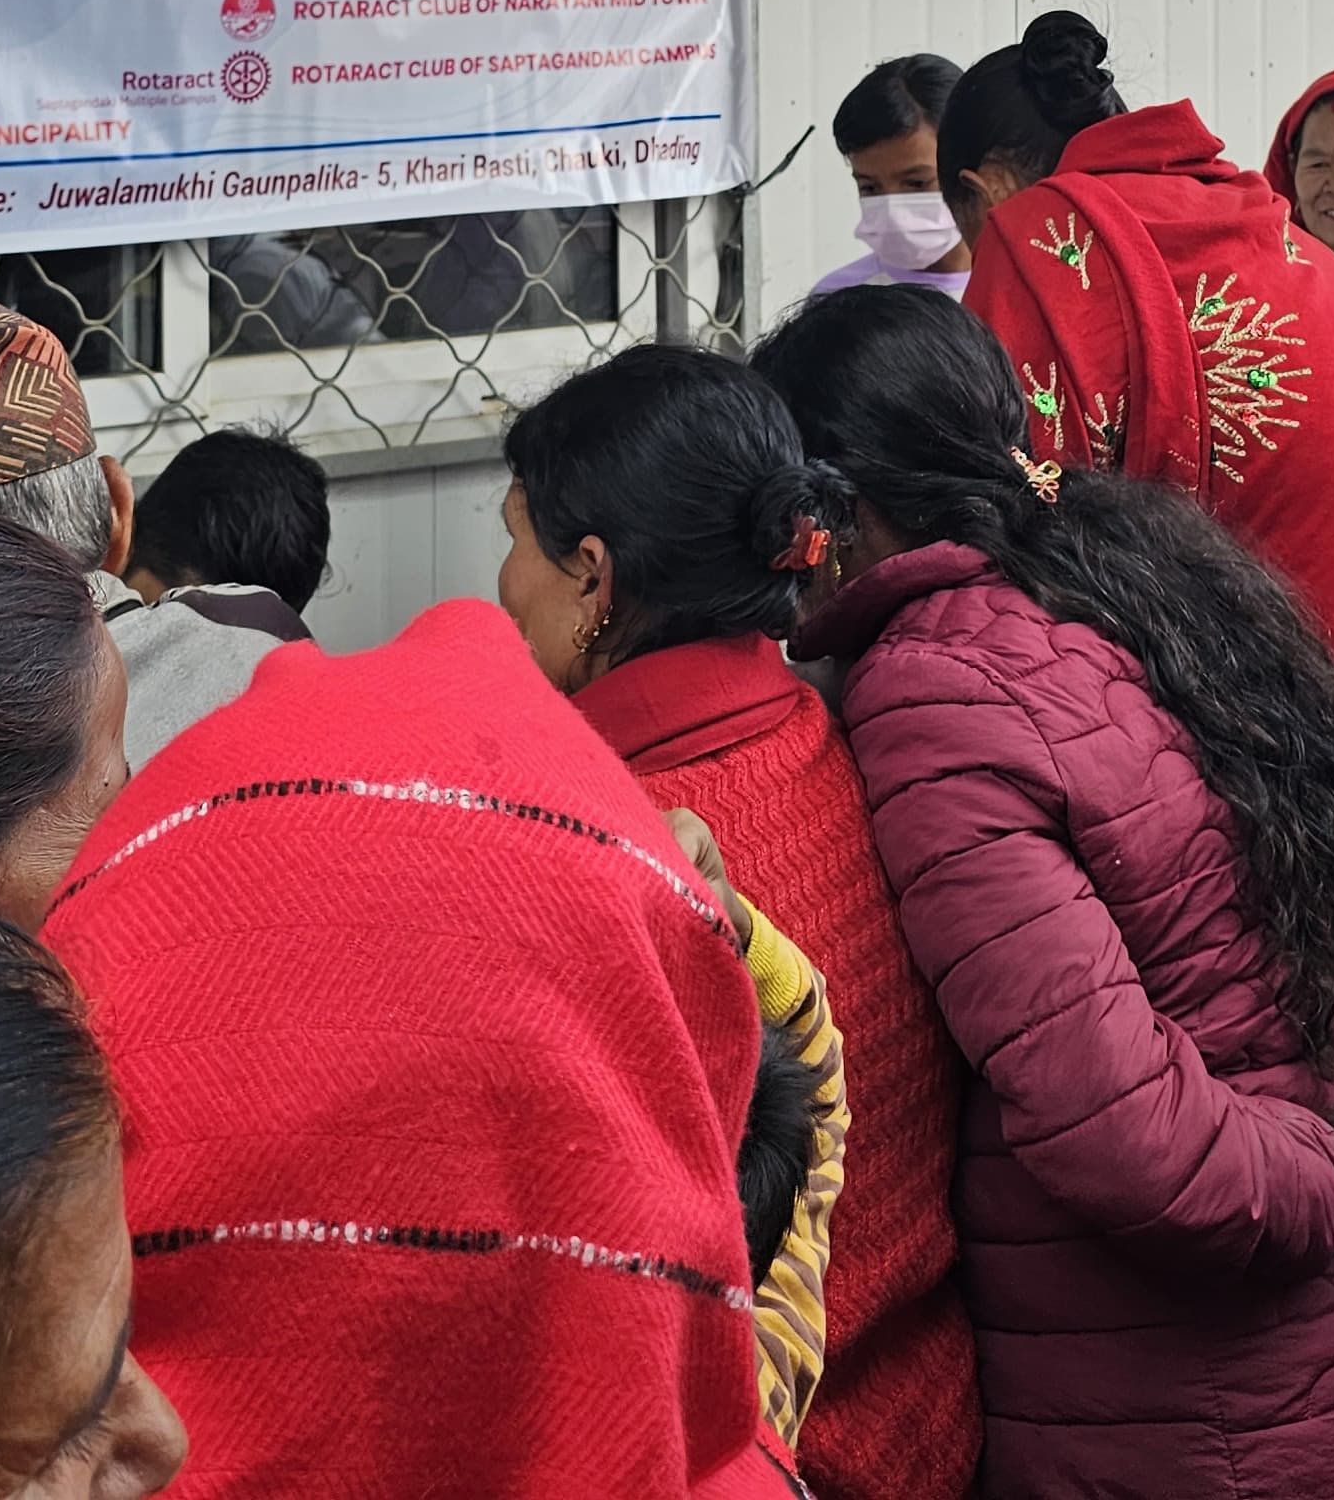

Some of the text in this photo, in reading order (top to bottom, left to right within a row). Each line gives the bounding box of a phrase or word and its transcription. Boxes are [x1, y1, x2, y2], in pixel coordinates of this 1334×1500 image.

[122, 70, 215, 90] Rotaract
[291, 43, 716, 84] ROTARACT CLUB OF SAPTAGANDAKI CAMPUS
[39, 170, 216, 210] Juwalamukhi
[405, 154, 466, 184] Khari
[474, 153, 537, 179] Basti,
[545, 142, 627, 172] Chauki,
[635, 135, 701, 165] Dhading
